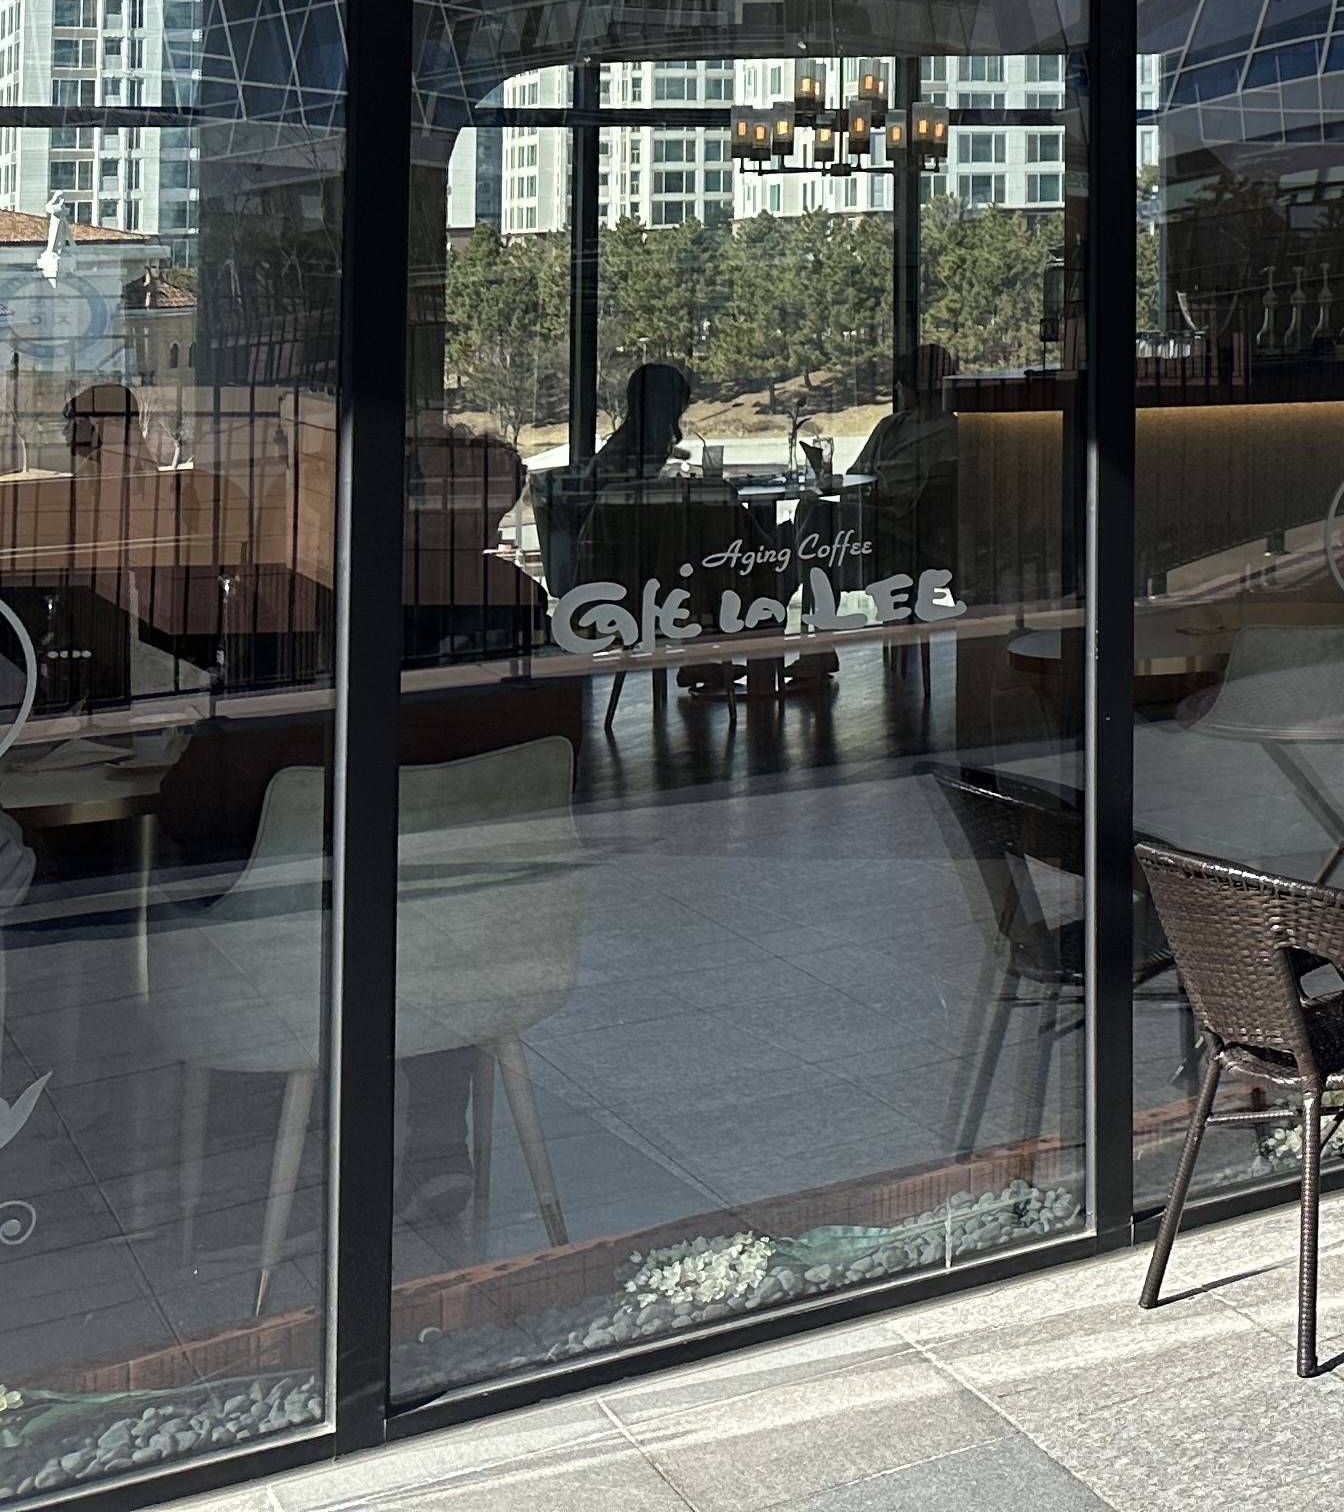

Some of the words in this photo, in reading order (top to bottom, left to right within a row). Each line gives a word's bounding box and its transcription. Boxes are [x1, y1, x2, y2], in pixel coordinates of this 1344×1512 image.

[702, 538, 792, 577] Aging
[798, 528, 873, 569] Coffee
[801, 566, 968, 632] LEE
